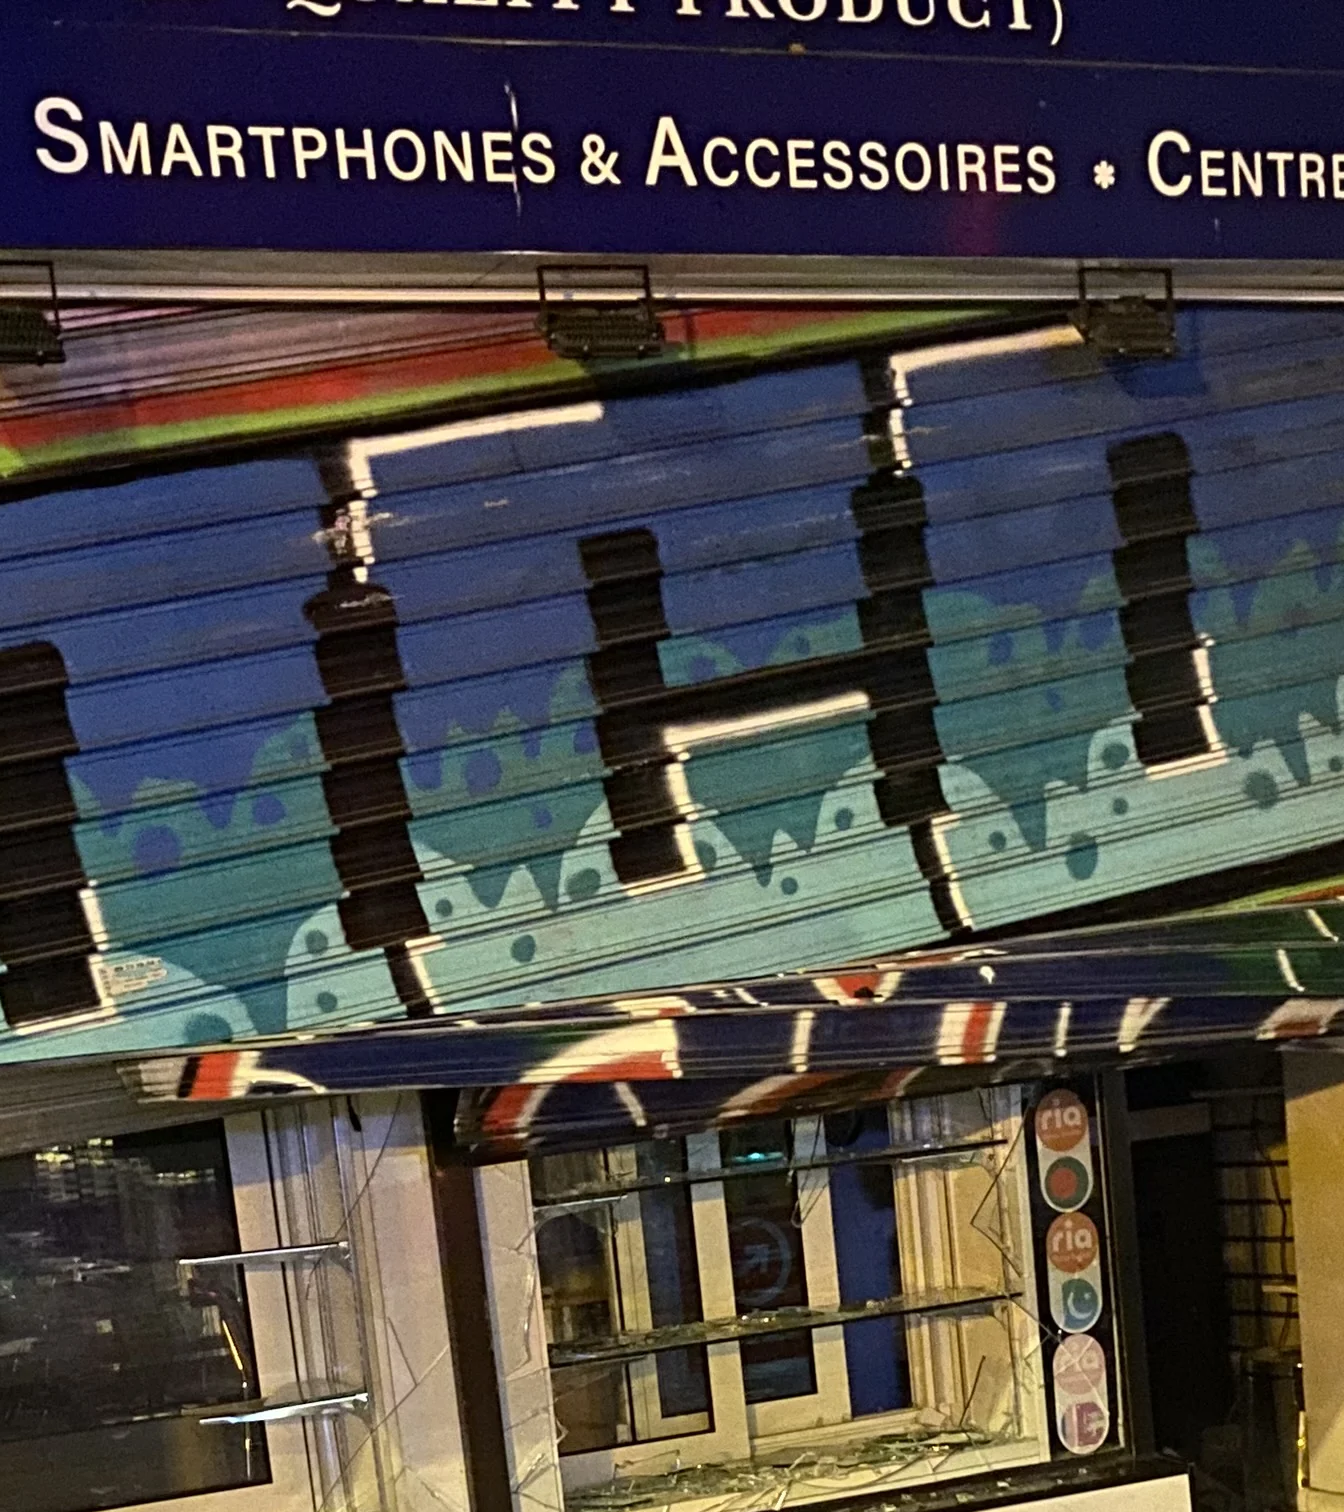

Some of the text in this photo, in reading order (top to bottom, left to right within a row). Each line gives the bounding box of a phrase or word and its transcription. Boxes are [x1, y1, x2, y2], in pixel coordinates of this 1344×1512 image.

[34, 95, 1057, 195] SMARTPHONES & ACCESSOIRES
[1040, 1099, 1083, 1131] ria
[1051, 1220, 1094, 1253] ria
